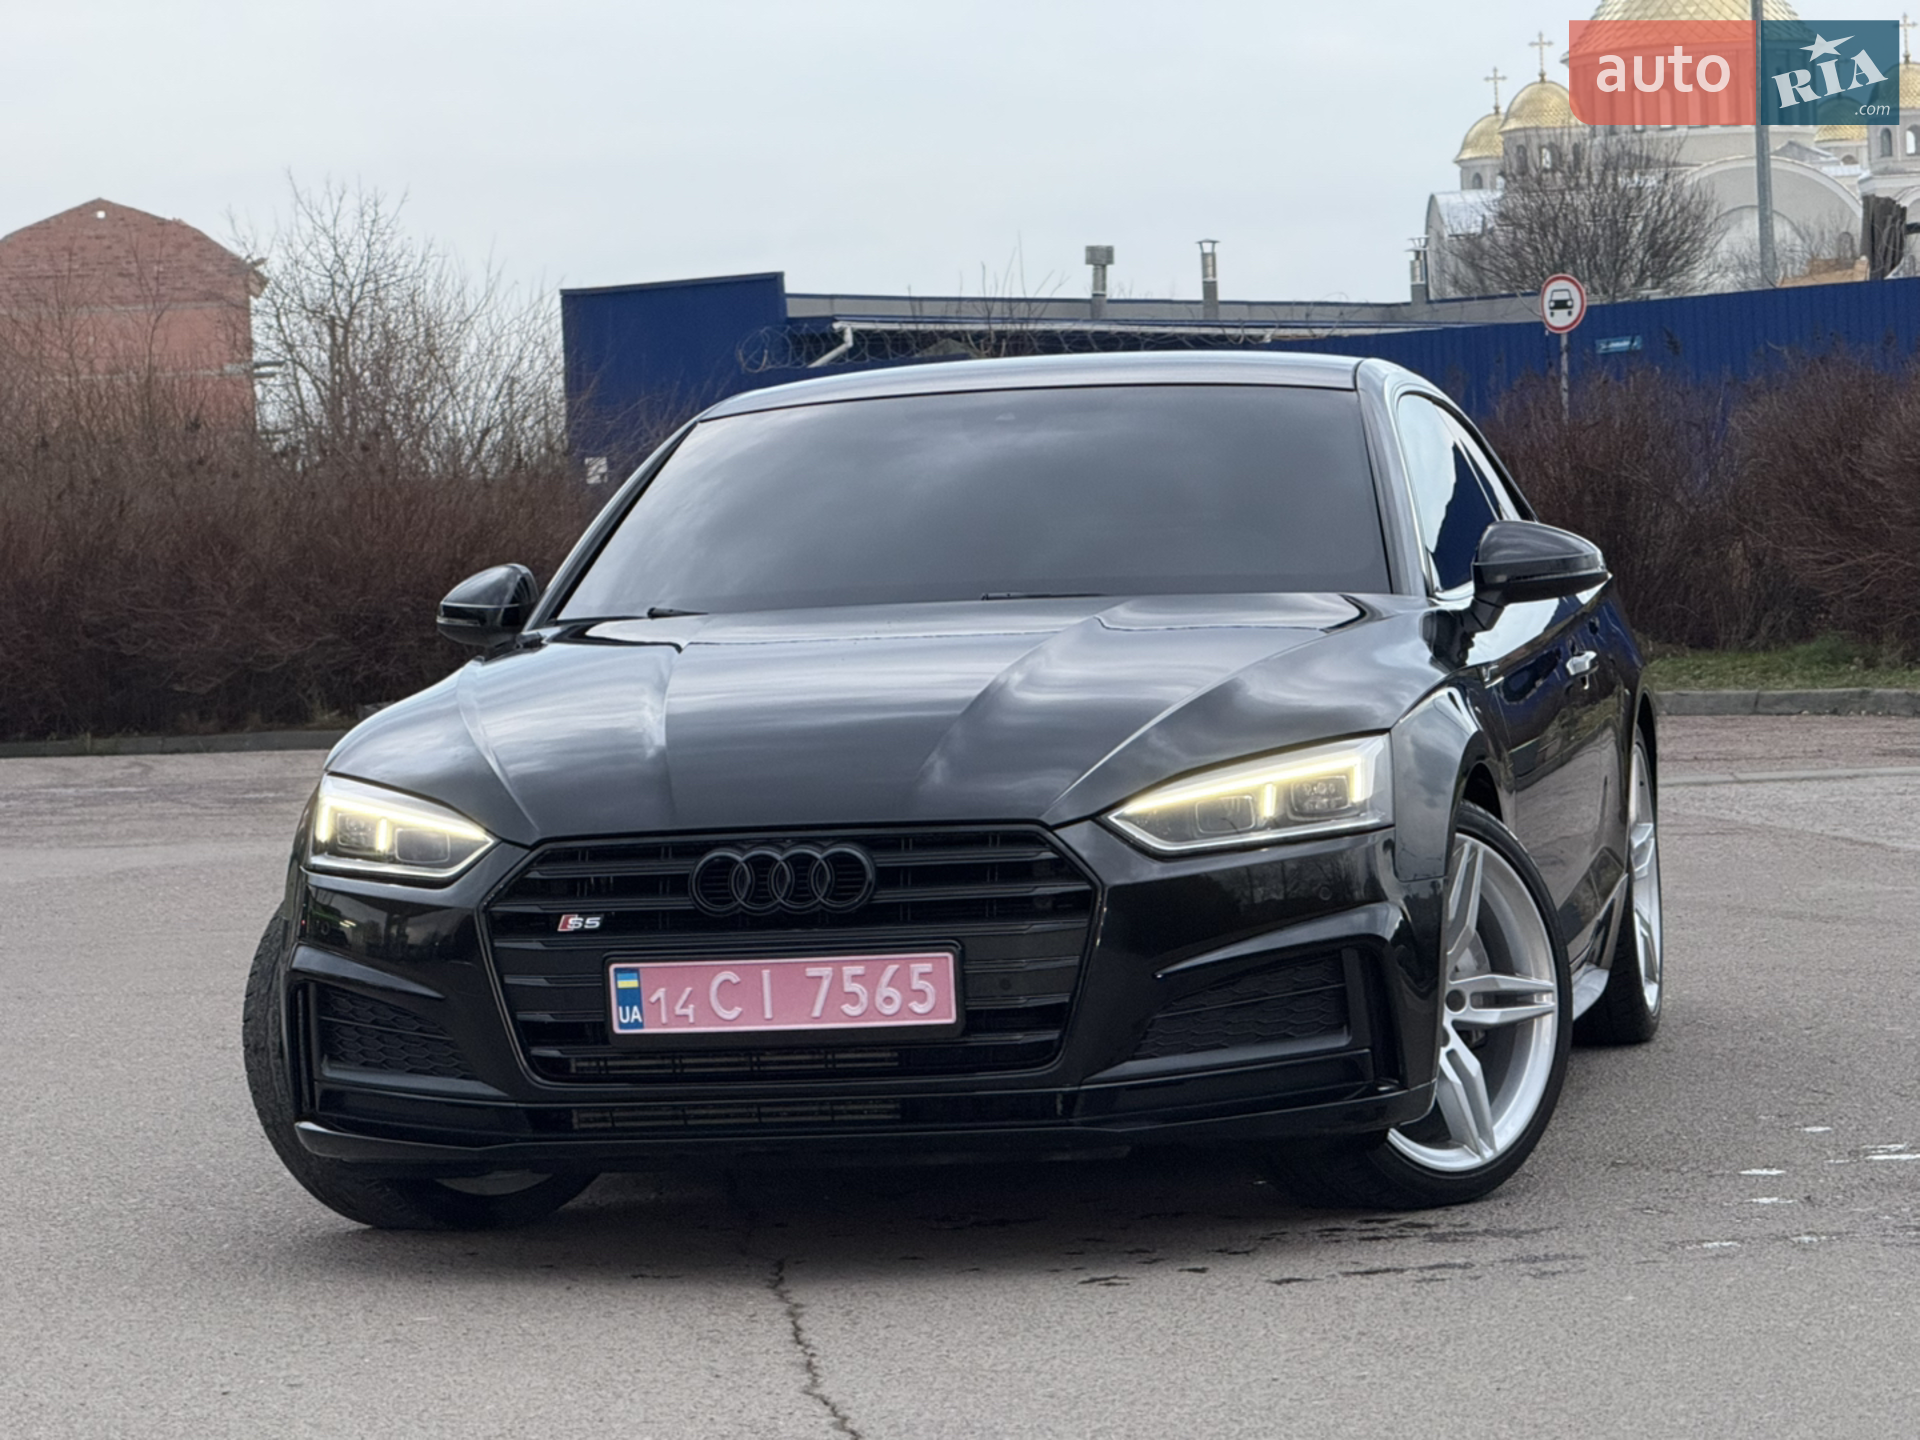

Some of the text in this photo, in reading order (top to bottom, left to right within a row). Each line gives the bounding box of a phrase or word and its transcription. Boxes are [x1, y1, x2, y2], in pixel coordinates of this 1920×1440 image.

[567, 916, 601, 929] S5
[805, 963, 937, 1017] 7565
[619, 1006, 642, 1024] UA
